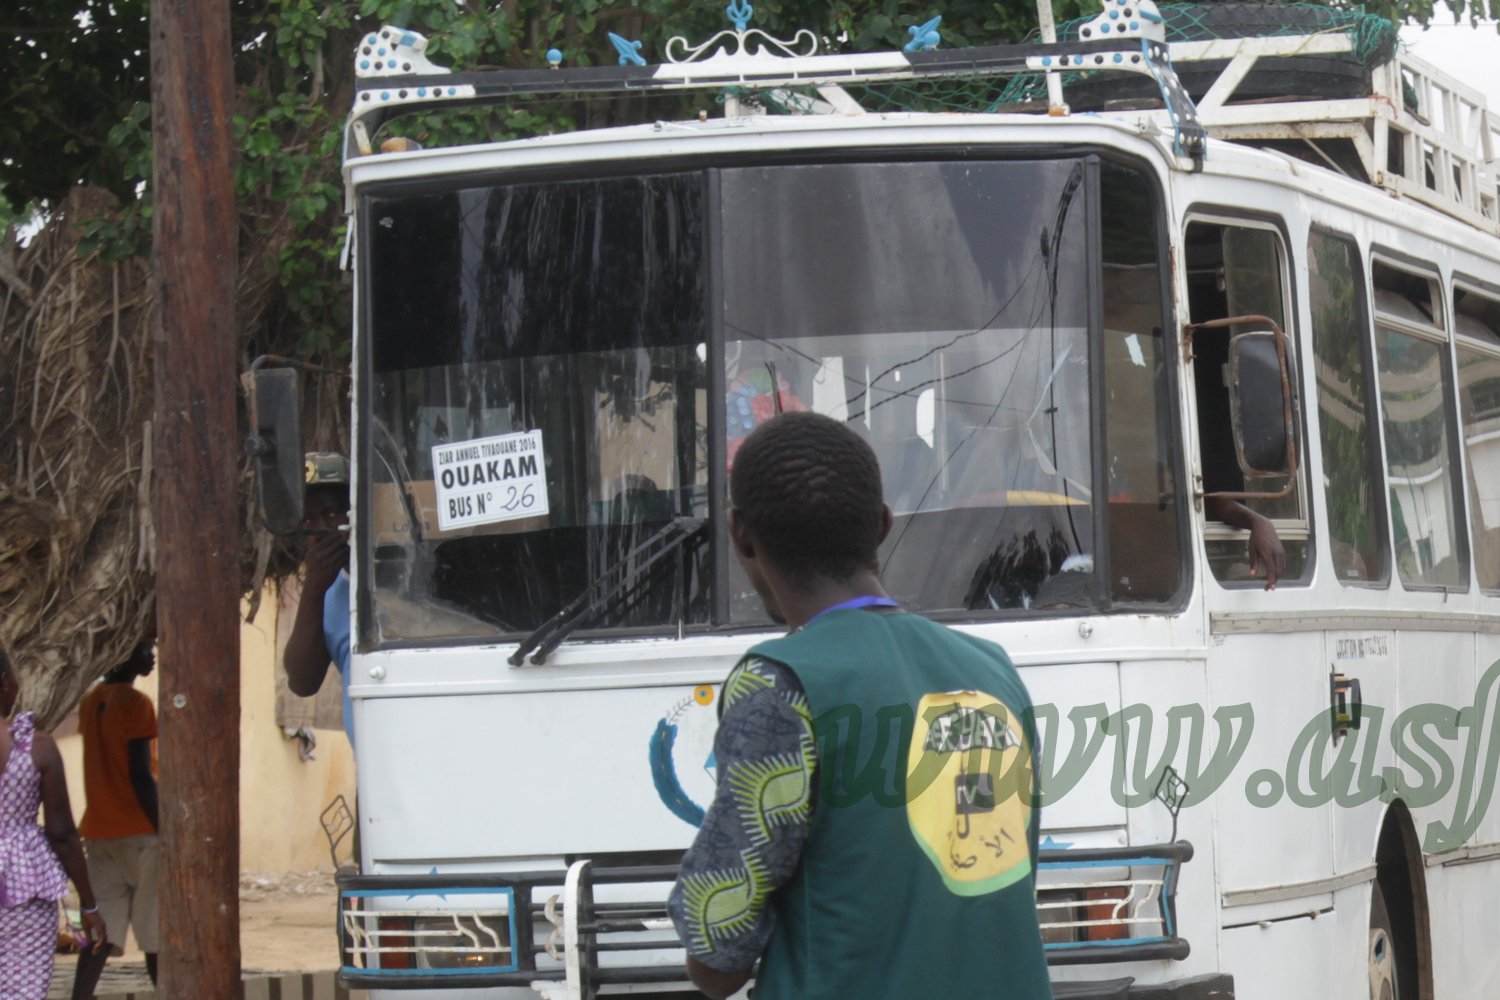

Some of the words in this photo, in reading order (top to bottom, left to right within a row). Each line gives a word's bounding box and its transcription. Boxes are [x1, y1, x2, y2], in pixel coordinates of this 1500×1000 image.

[438, 451, 454, 465] ZIAR
[456, 446, 480, 461] ANNUEL
[481, 440, 517, 458] TIVAOUANE
[519, 437, 536, 451] 2016
[441, 454, 538, 490] OUAKAM
[449, 495, 472, 519] BUS
[476, 491, 492, 515] N°
[500, 483, 535, 511] 26
